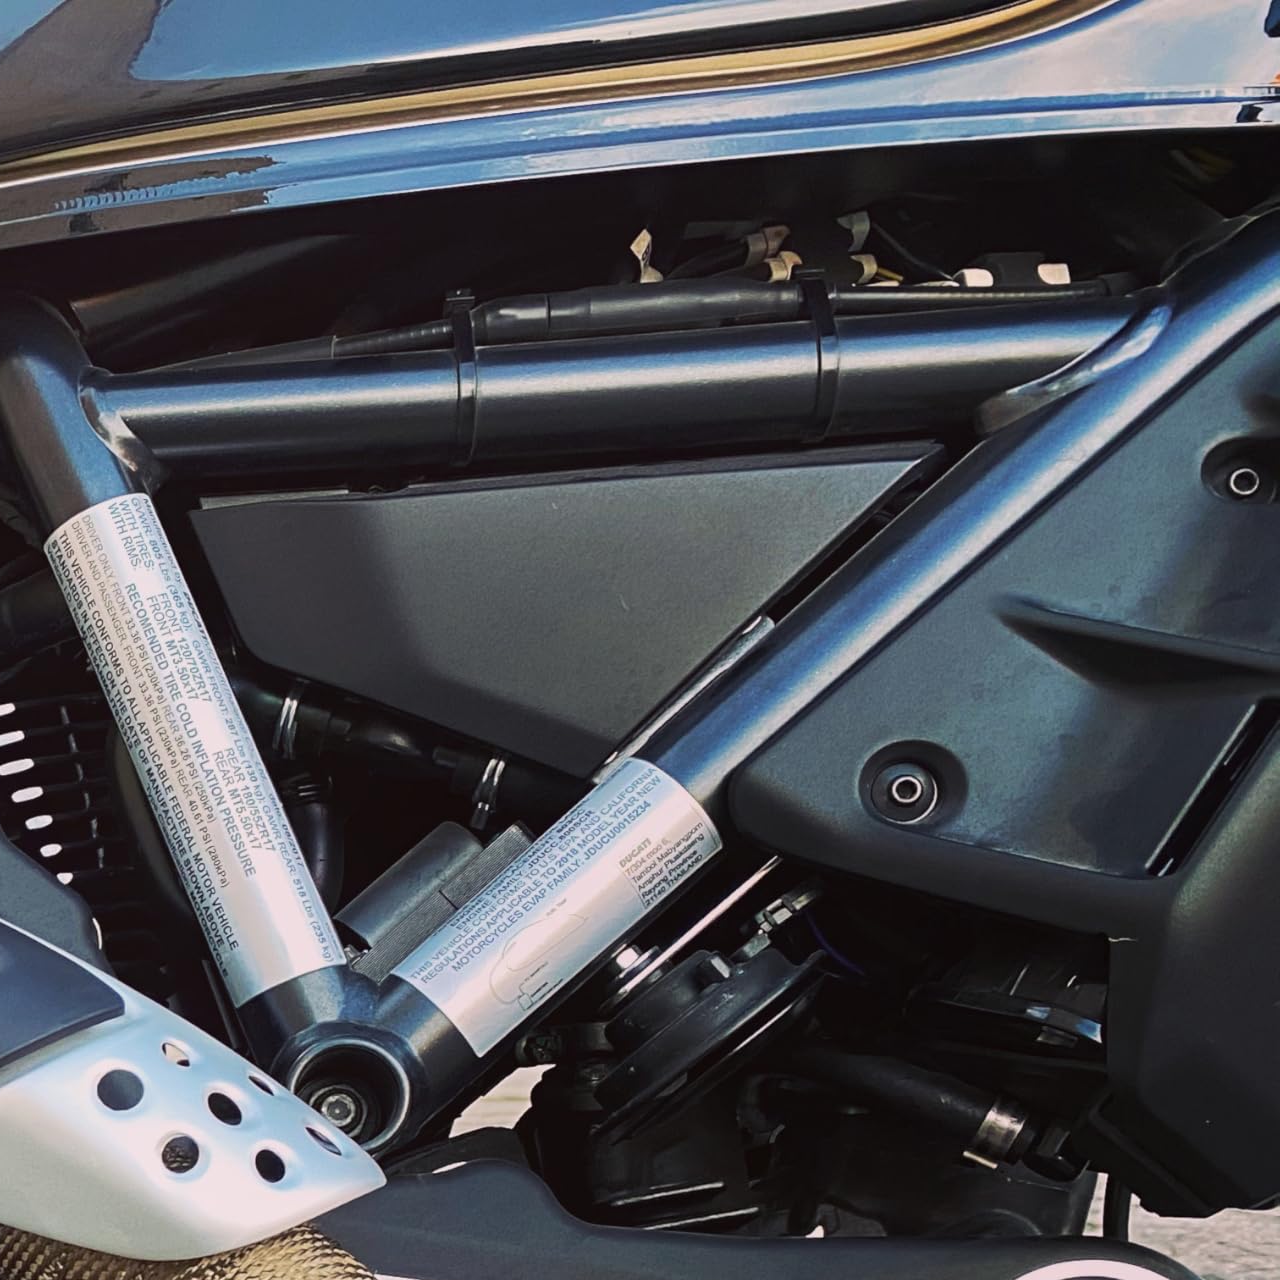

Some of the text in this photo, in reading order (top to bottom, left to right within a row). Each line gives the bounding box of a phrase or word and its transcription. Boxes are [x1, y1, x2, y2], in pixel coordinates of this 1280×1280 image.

[69, 520, 93, 560] DRIVER
[80, 514, 104, 553] DRIVER
[85, 558, 102, 582] AND
[108, 581, 131, 618] FRONT
[124, 617, 142, 644] 33.36
[122, 644, 143, 680] FRONT
[135, 643, 150, 662] PSI
[106, 502, 130, 538] WITH
[145, 594, 173, 640] FRONT
[163, 637, 199, 702] MT3.50x17
[211, 749, 235, 787] REAR
[226, 786, 262, 851] MT5.50x17
[117, 499, 140, 534] WITH
[156, 590, 183, 636] FRONT
[175, 635, 212, 705] 120/70ZR17
[222, 746, 246, 784] REAR
[238, 784, 276, 854] 180/55ZR17
[141, 661, 168, 705] (230kPa)
[136, 680, 155, 708] 33.36
[123, 582, 257, 878] RECOMENDED TIRE COLD INFLATION PRESSURE
[129, 495, 154, 538] GVWR:
[147, 537, 164, 561] 805
[157, 560, 173, 582] Lbs
[165, 582, 184, 610] (365
[190, 638, 212, 674] GAWR
[232, 737, 248, 758] Lbs
[240, 757, 258, 783] (130
[260, 803, 283, 840] GAWR
[300, 898, 316, 919] Lbs
[308, 919, 327, 945] (235
[319, 944, 335, 964] kg)
[148, 707, 163, 726] PSI
[160, 704, 180, 735] REAR
[48, 539, 225, 948] STANDARDS IN EFFECT ON THE DATE OF MANUFACTURE SHOWN ABOVE
[56, 529, 240, 951] THIS VEHICLE CONFORMS TO ALL APPLICABLE FEDERAL MOTOR VEHICLE
[154, 725, 181, 769] (230kPa)
[173, 734, 192, 762] 36.26
[174, 768, 193, 799] REAR
[185, 761, 200, 781] PSI
[186, 798, 205, 826] 40.61
[191, 779, 218, 824] (250kPa)
[197, 825, 212, 845] PSI
[204, 844, 231, 888] (280kPa)
[617, 837, 652, 868] DUCATI
[666, 853, 703, 886] THAILAND
[667, 848, 698, 876] Province
[409, 959, 433, 981] THIS
[431, 924, 474, 962] VEHICLE
[471, 878, 526, 928] CONFORMS
[524, 866, 540, 881] TO
[538, 851, 558, 869] U.S.
[557, 832, 579, 852] EPA
[578, 813, 601, 834] AND
[599, 765, 656, 816] CALIFORNIA
[420, 925, 487, 985] REGULATIONS
[484, 877, 543, 929] APPLICABLE
[538, 864, 558, 883] TO
[554, 846, 579, 869] 2018
[576, 816, 613, 850] MODEL
[609, 794, 639, 821] YEAR
[635, 774, 662, 799] NEW
[631, 859, 658, 884] Tambol
[636, 866, 665, 892] Amphur
[449, 895, 486, 928] ENGINE
[455, 898, 492, 931] ENGINE
[188, 890, 229, 978] MOTORCYCLE
[451, 908, 524, 973] MOTORCYCLES
[521, 886, 549, 913] EVAP
